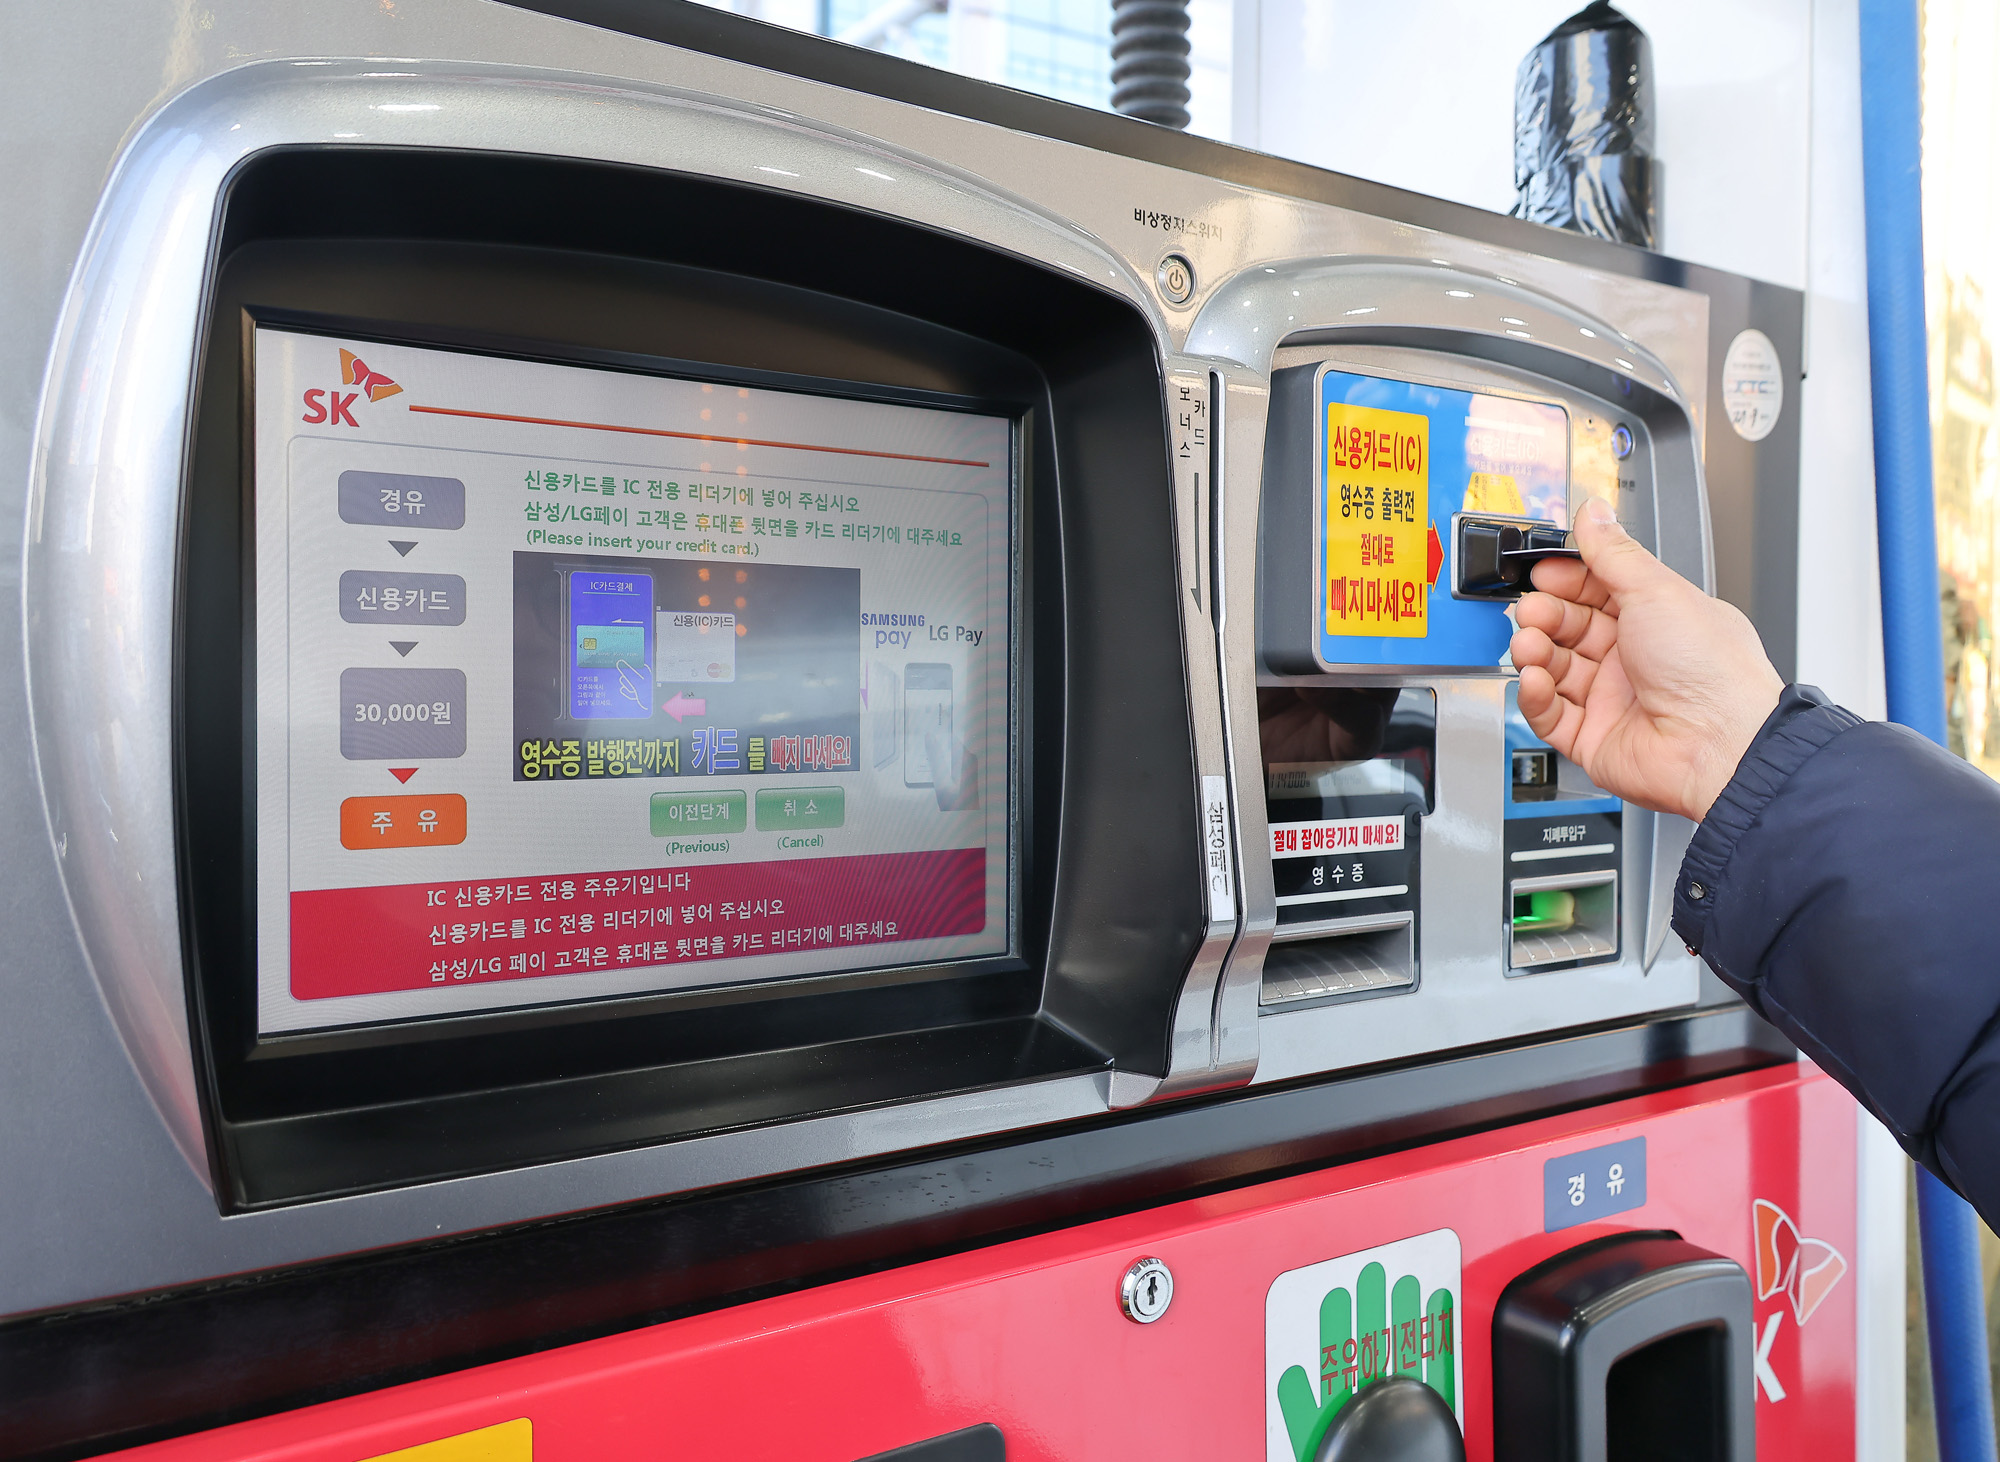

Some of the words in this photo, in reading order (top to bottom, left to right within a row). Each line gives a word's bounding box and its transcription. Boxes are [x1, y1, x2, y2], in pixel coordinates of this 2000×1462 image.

[302, 388, 360, 428] SK
[1194, 400, 1205, 445] 카드
[1334, 425, 1422, 475] 신용카드(IC)
[380, 489, 426, 515] 경유
[524, 470, 617, 496] 신용카드를
[623, 479, 640, 495] IC
[647, 479, 681, 500] 전용
[688, 483, 754, 506] 리더기에
[762, 489, 792, 509] 넣어
[798, 492, 860, 512] 주십시오
[1340, 484, 1374, 520] 영수증
[1382, 487, 1415, 523] 출력전
[524, 501, 628, 527] 삼성/LG페이
[636, 509, 688, 531] 고객은
[695, 513, 745, 534] 휴대폰
[751, 517, 799, 537] 뒷면을
[805, 520, 836, 539] 카드
[842, 523, 900, 544] 리더기에
[907, 527, 963, 547] 대주세요
[526, 529, 583, 546] (Please
[588, 532, 632, 548] insert
[637, 537, 671, 553] your
[676, 540, 717, 554] credit
[722, 541, 760, 557] card.)
[1361, 533, 1394, 567] 절대로
[356, 586, 450, 612] 신용카드
[590, 581, 633, 592] IC카드결제
[1331, 576, 1423, 622] 빼지마세요!
[673, 615, 734, 628] 신용(IC)카드
[861, 613, 925, 627] SAMSUNG
[929, 625, 949, 642] LG
[955, 626, 983, 646] Pay
[875, 629, 912, 649] pay
[354, 701, 451, 725] 30,000원
[521, 738, 581, 778] 영수증
[587, 738, 680, 775] 발행전까지
[691, 726, 740, 775] 카드
[748, 737, 766, 770] 를
[771, 735, 800, 770] 빼지
[804, 736, 851, 770] 마세요!
[371, 809, 439, 835] 주유
[669, 802, 730, 821] 이전단계
[665, 840, 730, 856] (Previous)
[777, 834, 824, 850] (Cancel)
[1273, 829, 1297, 852] 절대
[1301, 826, 1358, 850] 잡아당기지
[1363, 824, 1400, 846] 마세요!
[1543, 825, 1586, 843] 지폐투입구
[426, 890, 447, 907] IC
[454, 883, 532, 908] 신용카드
[540, 880, 577, 902] 전용
[584, 872, 691, 898] 주유기입니다
[428, 918, 527, 946] 신용카드를
[534, 917, 552, 934] IC
[559, 913, 596, 935] 전용
[603, 906, 673, 930] 리더기에
[681, 903, 713, 925] 넣어
[719, 899, 785, 921] 주십시오
[428, 957, 502, 982] 삼성/LG
[509, 950, 546, 974] 페이
[554, 946, 609, 969] 고객은
[616, 939, 669, 962] 휴대폰
[675, 935, 726, 958] 뒷면을
[732, 932, 765, 951] 카드
[771, 925, 833, 948] 리더기에
[839, 920, 899, 942] 대주세요
[1567, 1163, 1625, 1206] 경유
[1321, 1308, 1453, 1395] 주유하기전터치
[1752, 1311, 1787, 1403] K
